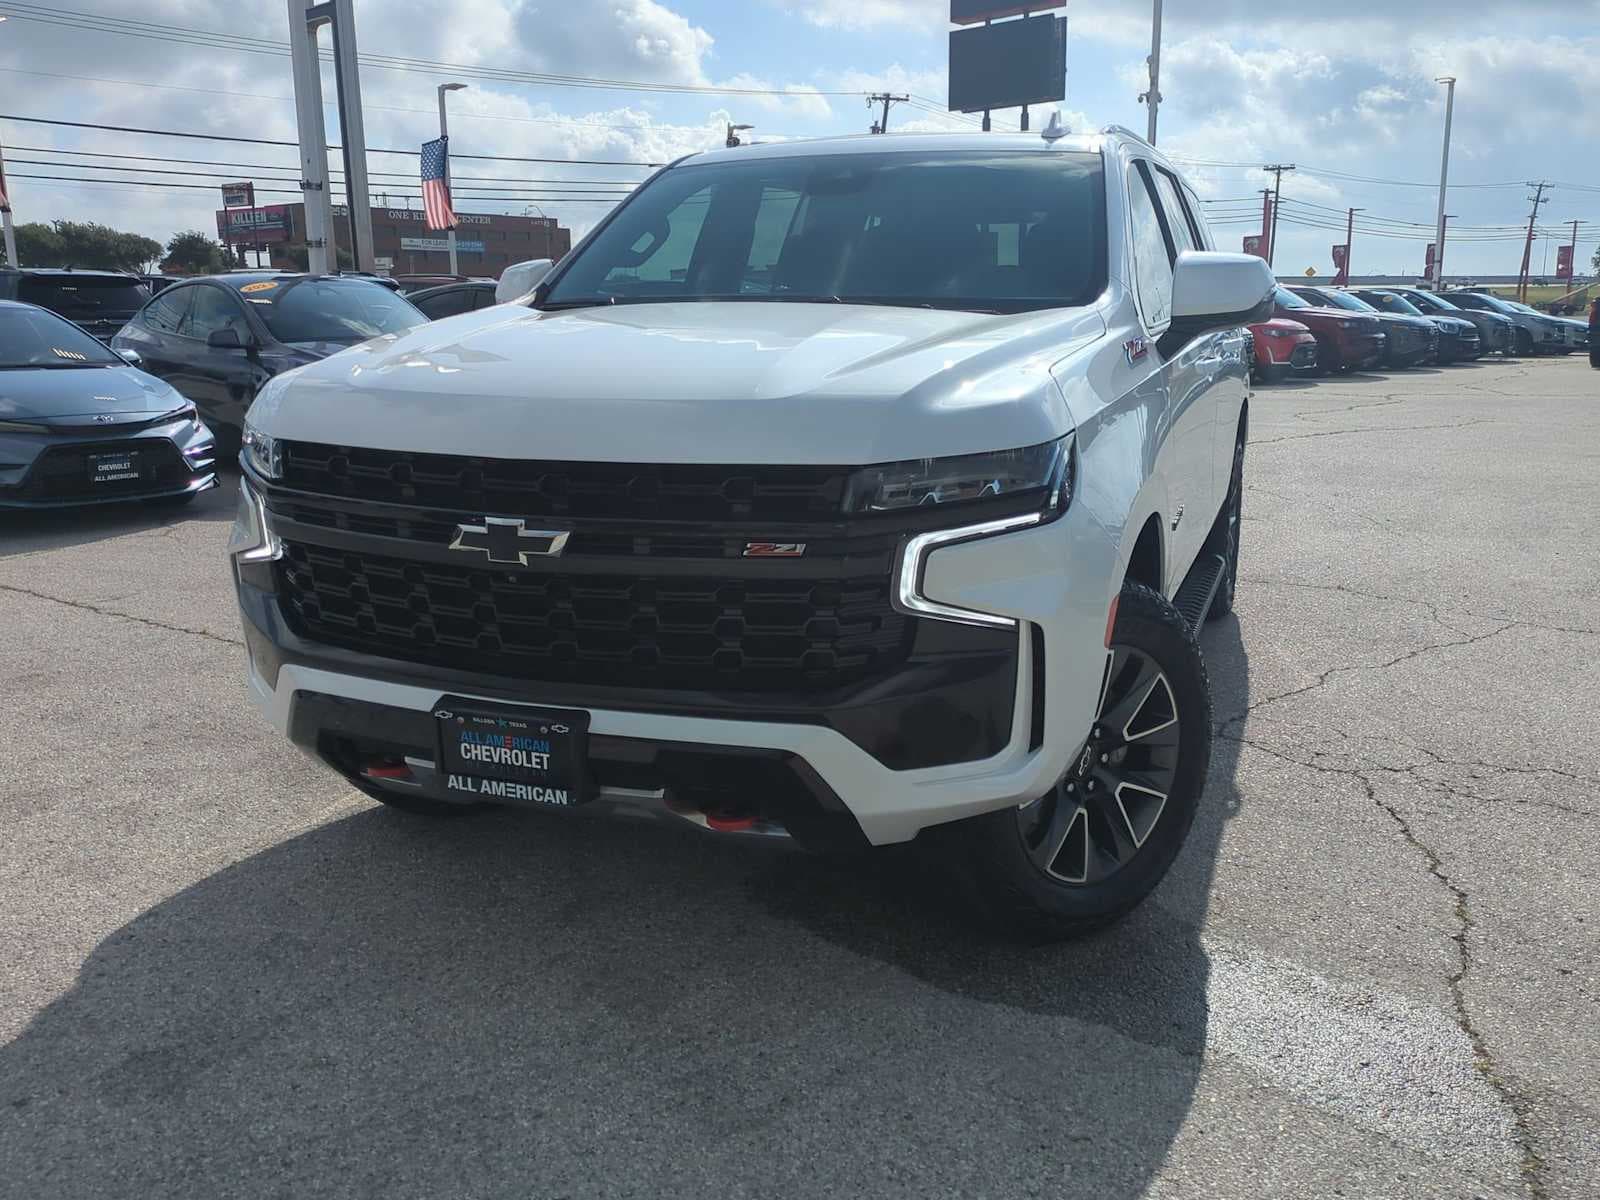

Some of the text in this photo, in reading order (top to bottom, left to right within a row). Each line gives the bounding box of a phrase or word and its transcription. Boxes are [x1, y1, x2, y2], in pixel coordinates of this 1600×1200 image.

[389, 211, 410, 221] ONE
[457, 215, 491, 224] CENTER
[98, 462, 131, 471] CHEVROLET
[107, 472, 139, 480] AMERICAN
[743, 543, 806, 557] Z71
[508, 721, 528, 729] TEXAS
[460, 731, 550, 753] ALL AMERICAN
[460, 742, 550, 770] CHEVROLET
[447, 774, 568, 805] ALL AMERICAN
